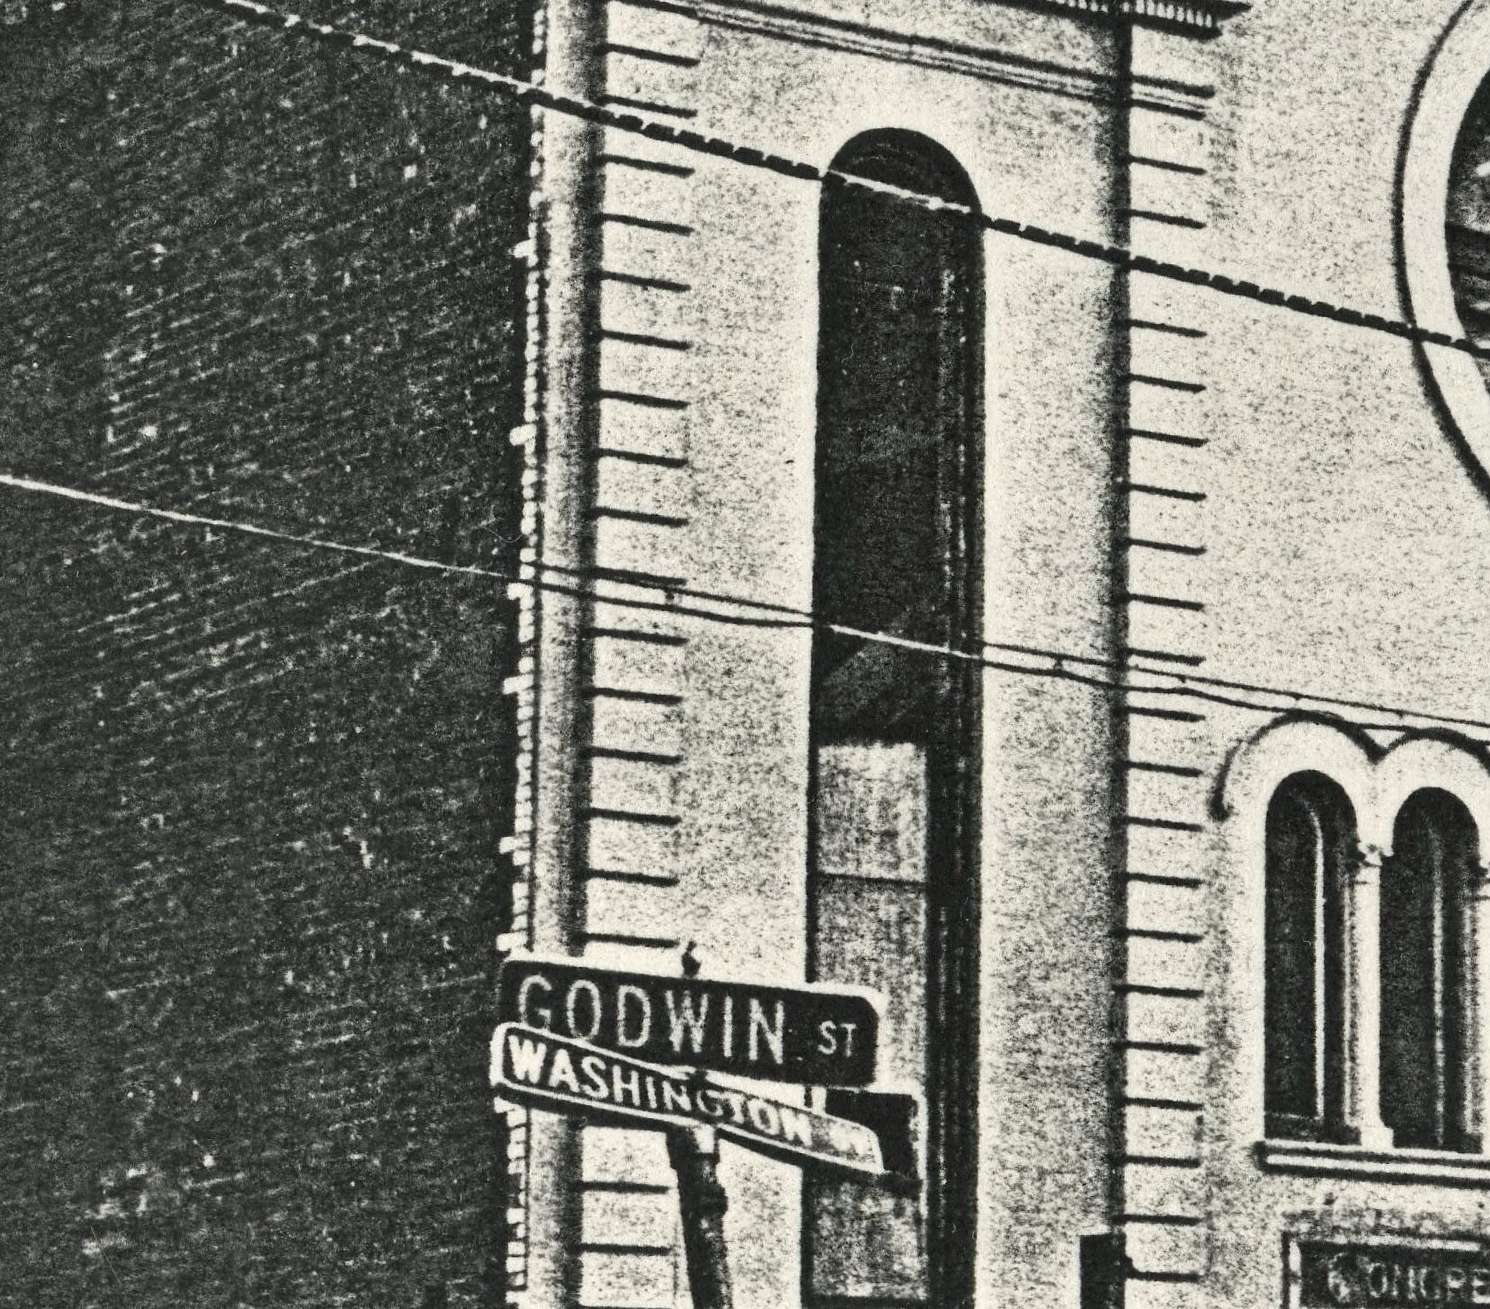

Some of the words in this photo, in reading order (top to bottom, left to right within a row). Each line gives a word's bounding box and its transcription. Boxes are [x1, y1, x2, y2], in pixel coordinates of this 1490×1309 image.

[517, 974, 787, 1065] GODWIN
[816, 1020, 857, 1058] ST
[508, 1033, 813, 1147] WASHINGTON
